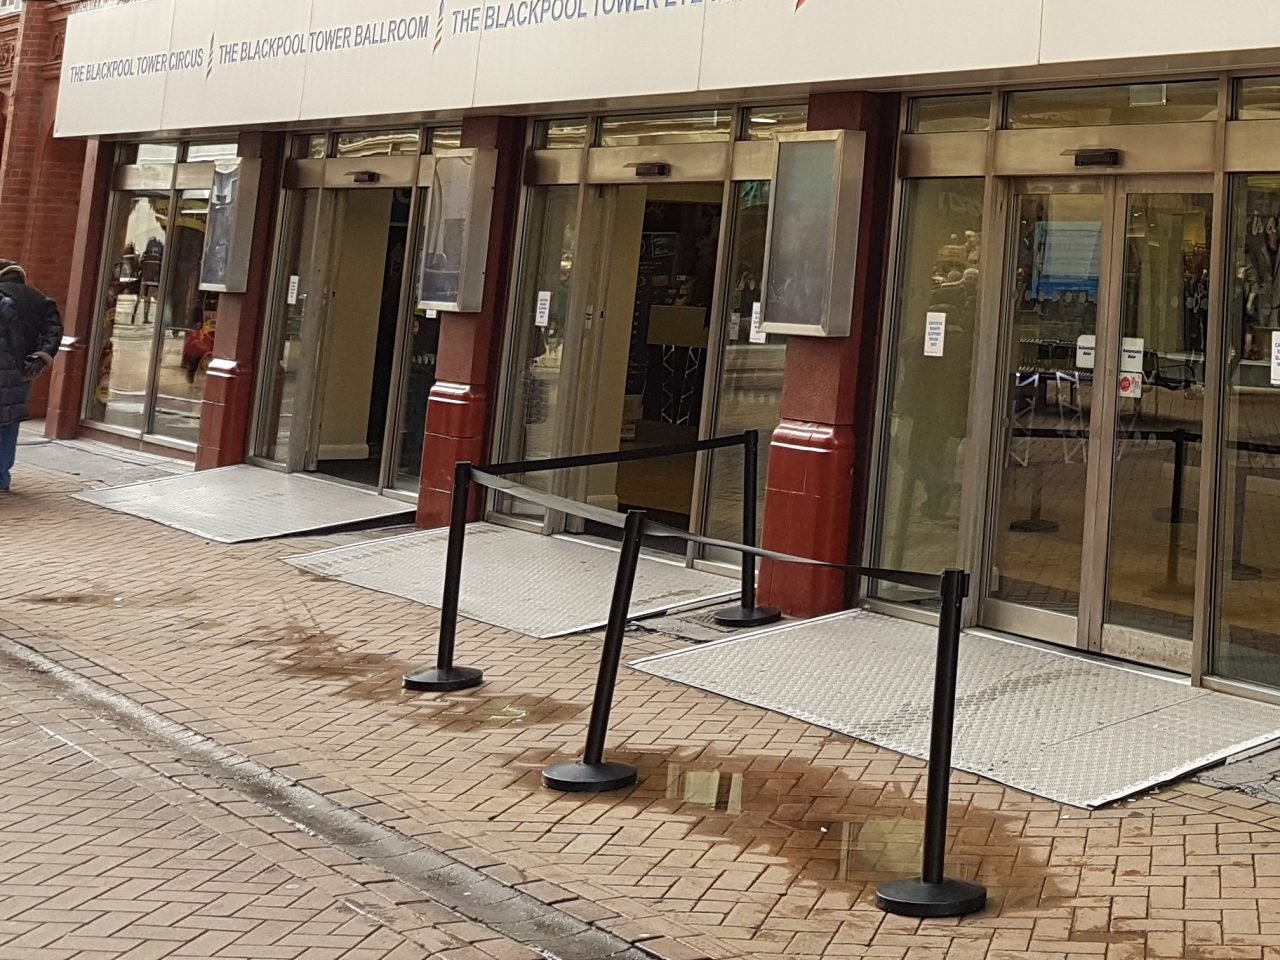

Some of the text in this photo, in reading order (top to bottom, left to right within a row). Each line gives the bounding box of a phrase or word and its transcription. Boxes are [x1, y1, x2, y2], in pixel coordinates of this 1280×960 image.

[452, 7, 480, 35] THE
[219, 15, 430, 65] THE BLACKPOOL TOWER BALLROOM
[70, 48, 204, 83] THE BLACKPOOL TOWER CIRCUS
